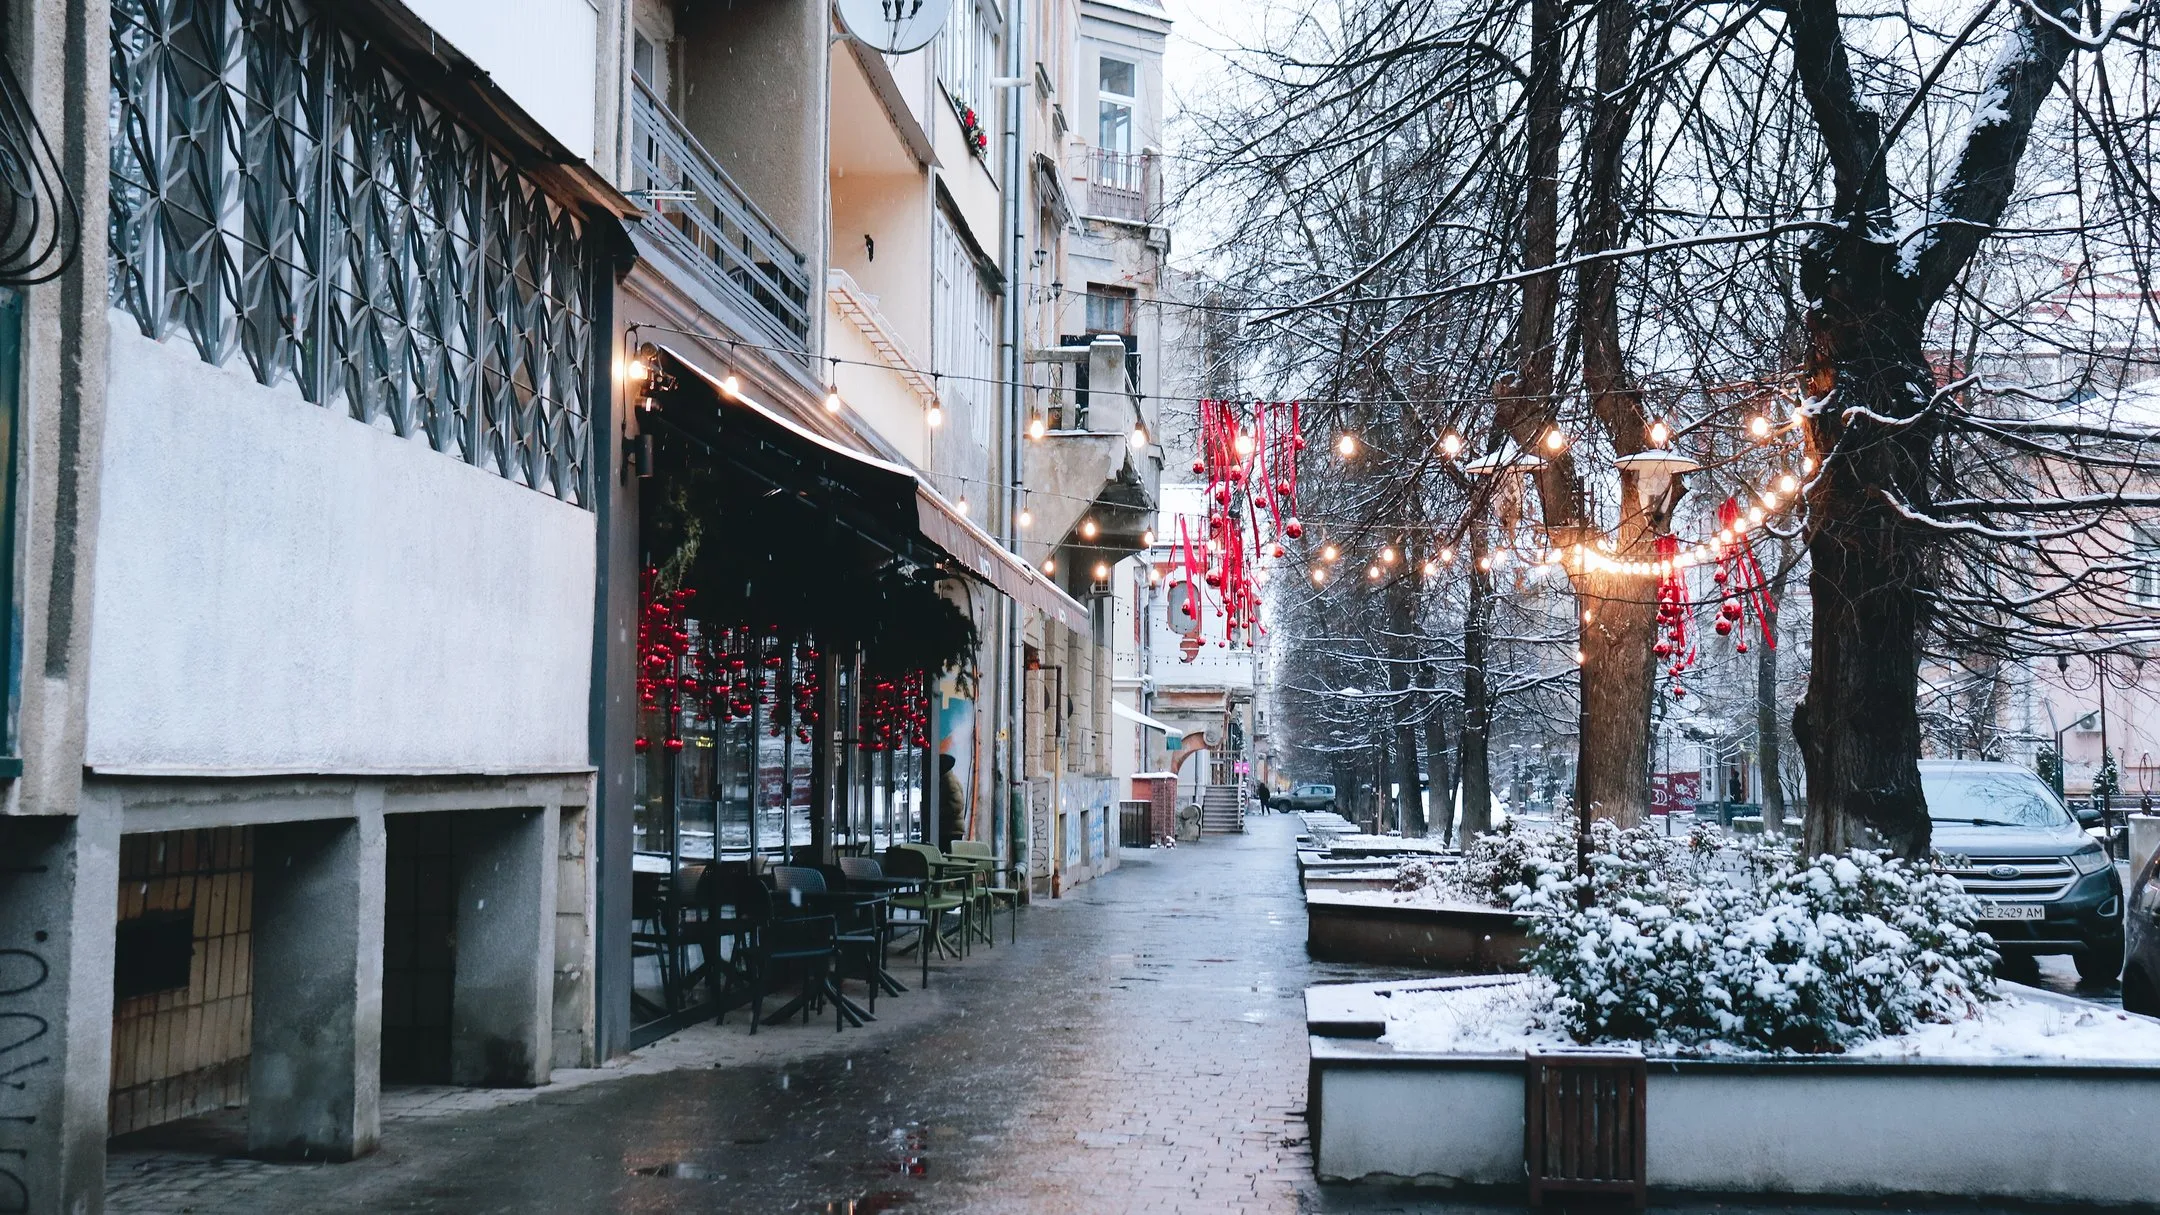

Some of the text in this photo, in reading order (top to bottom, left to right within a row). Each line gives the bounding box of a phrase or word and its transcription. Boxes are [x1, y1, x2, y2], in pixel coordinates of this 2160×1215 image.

[1995, 867, 2014, 875] Ford
[1979, 907, 2042, 918] KE 2429 AM
